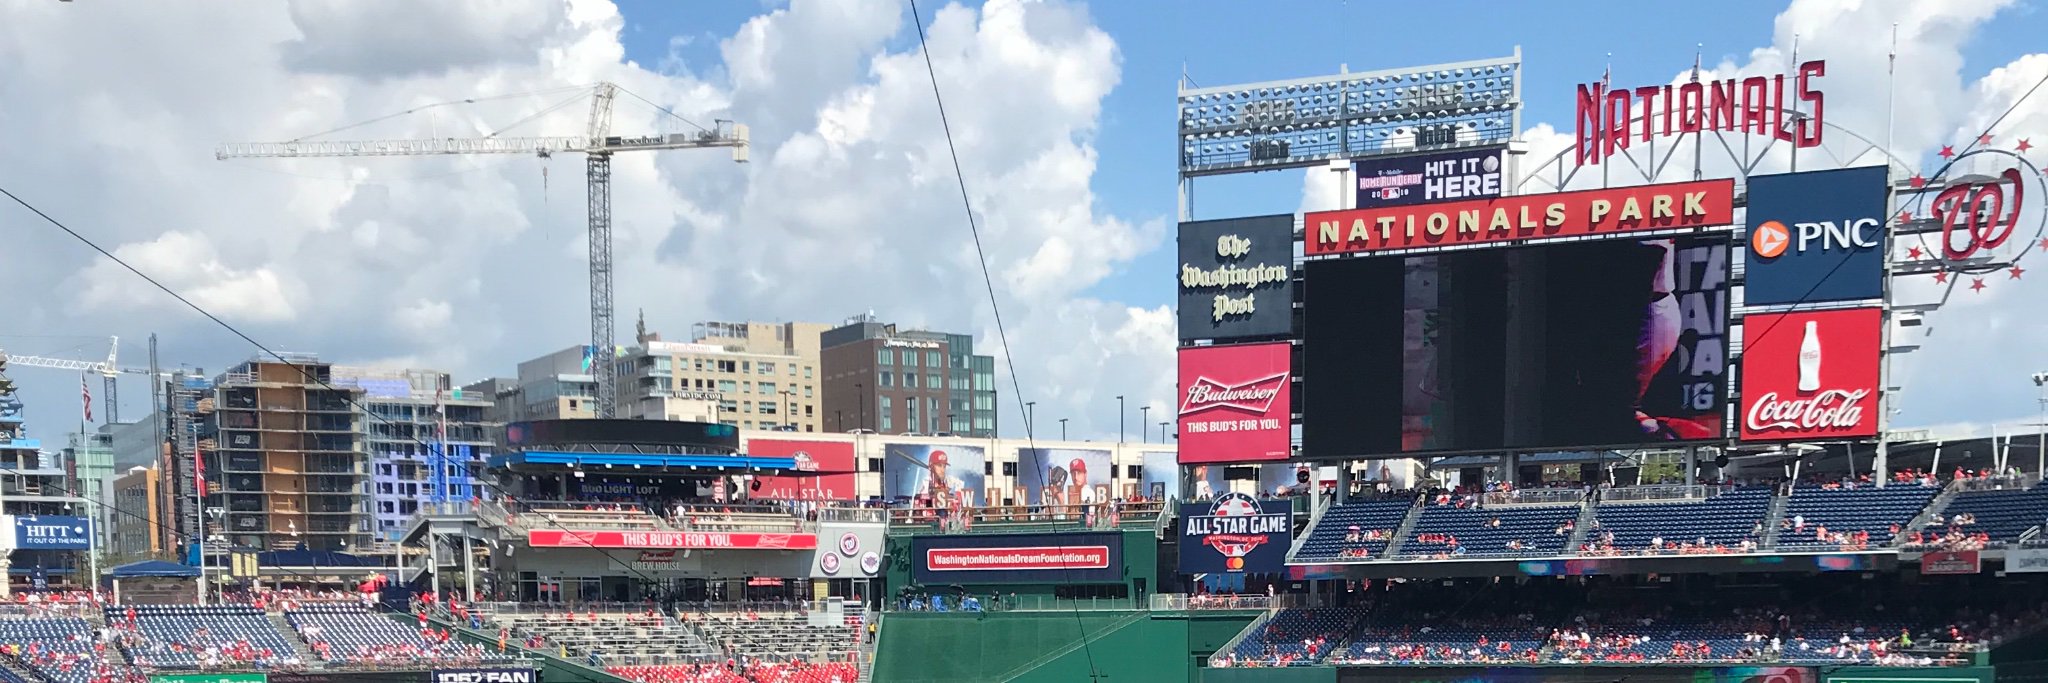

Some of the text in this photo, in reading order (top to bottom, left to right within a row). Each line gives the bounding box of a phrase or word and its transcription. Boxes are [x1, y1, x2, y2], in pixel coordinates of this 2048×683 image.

[1575, 59, 1826, 167] NATIONALS
[1425, 157, 1480, 177] HIT IT
[1319, 190, 1709, 245] NATIONALS PARK
[1793, 217, 1879, 253] PNC
[1216, 234, 1251, 257] The
[1181, 261, 1288, 290] Washington
[1212, 292, 1255, 324] Post
[1188, 384, 1278, 404] Budweiser
[1746, 387, 1871, 431] Coca-Cola
[1187, 418, 1282, 433] THIS BUD'S FOR YOU.
[581, 484, 660, 495] BUD LIGHT LOFT
[771, 487, 834, 500] ALL STAR
[26, 525, 70, 537] HITT
[1186, 515, 1287, 536] ALL STAR GAME
[621, 532, 648, 546] THIS
[649, 533, 683, 546] BUD'S
[685, 534, 706, 546] FOR
[708, 534, 734, 547] YOU.
[933, 551, 1101, 567] WashingtonNationalsDreamFoundation.org
[486, 671, 530, 683] FAN
